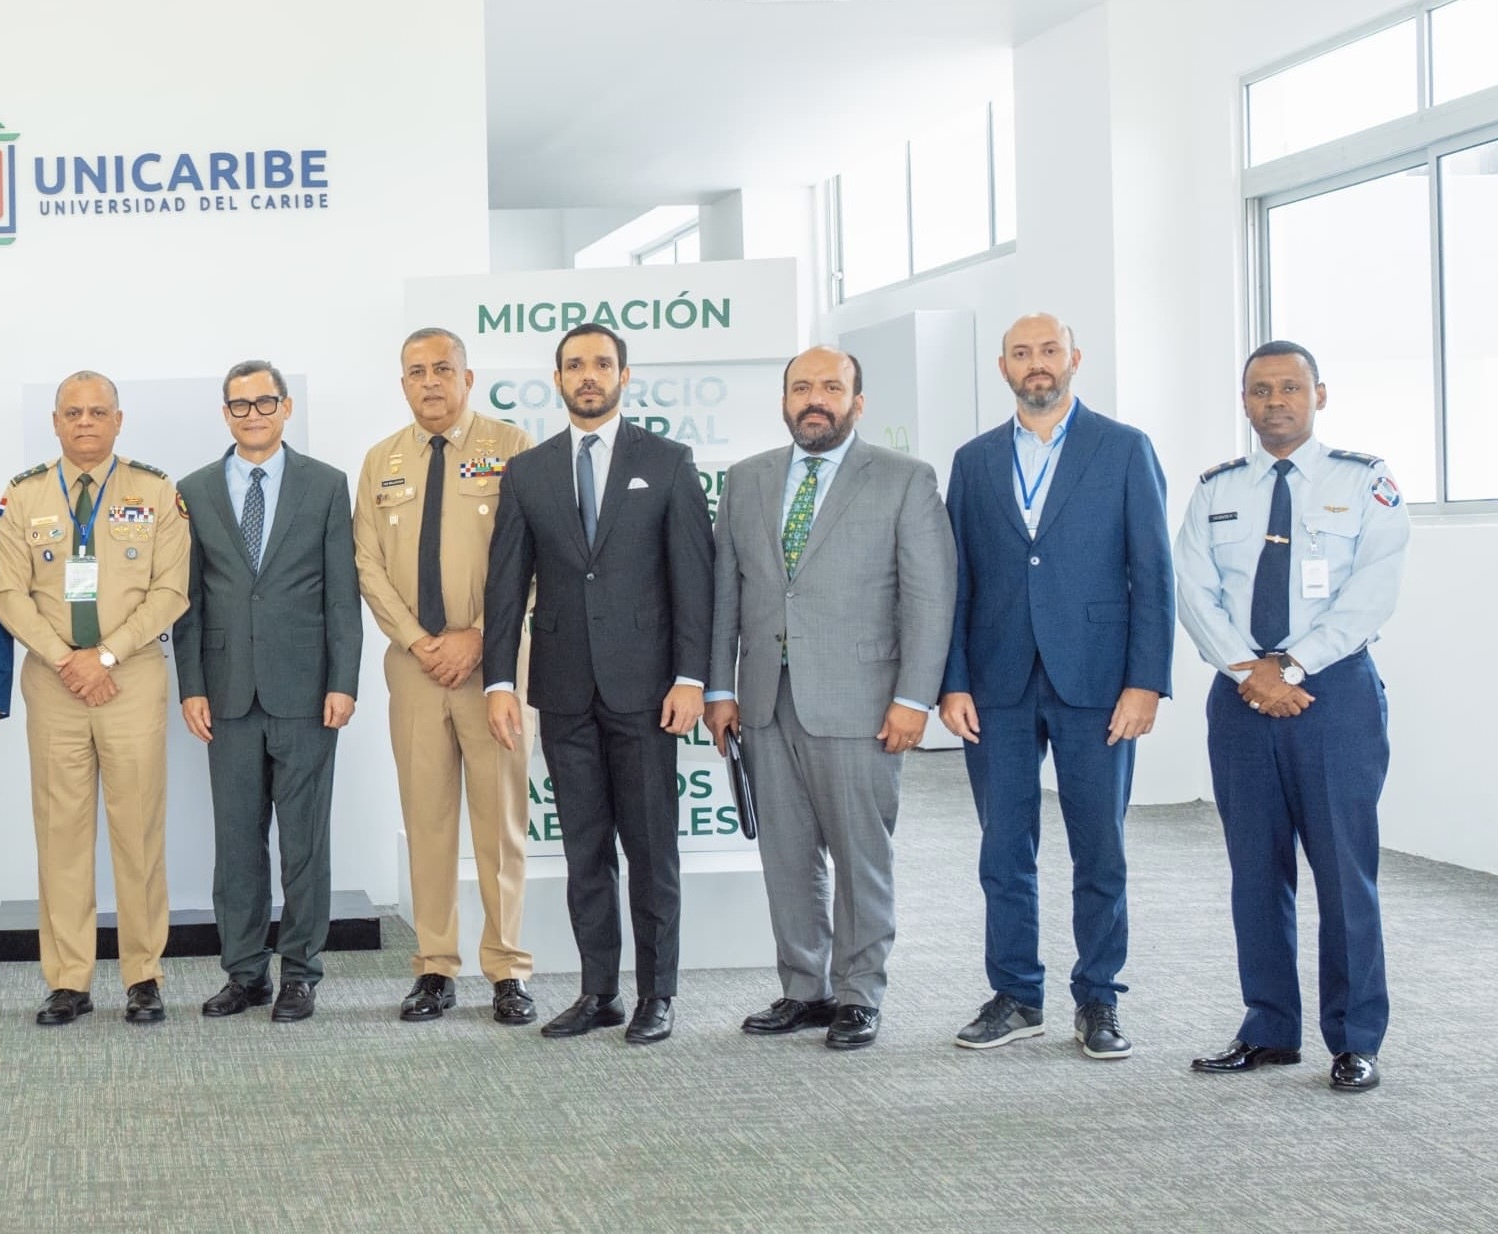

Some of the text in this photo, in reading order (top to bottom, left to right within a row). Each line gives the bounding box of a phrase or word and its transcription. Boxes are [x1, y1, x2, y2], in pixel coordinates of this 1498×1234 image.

[34, 149, 329, 195] UNICARIBE
[39, 194, 330, 216] UNIVERSIDAD DEL CARIBE
[478, 290, 731, 334] MIGRACIÓN
[489, 376, 728, 411] CORCIO
